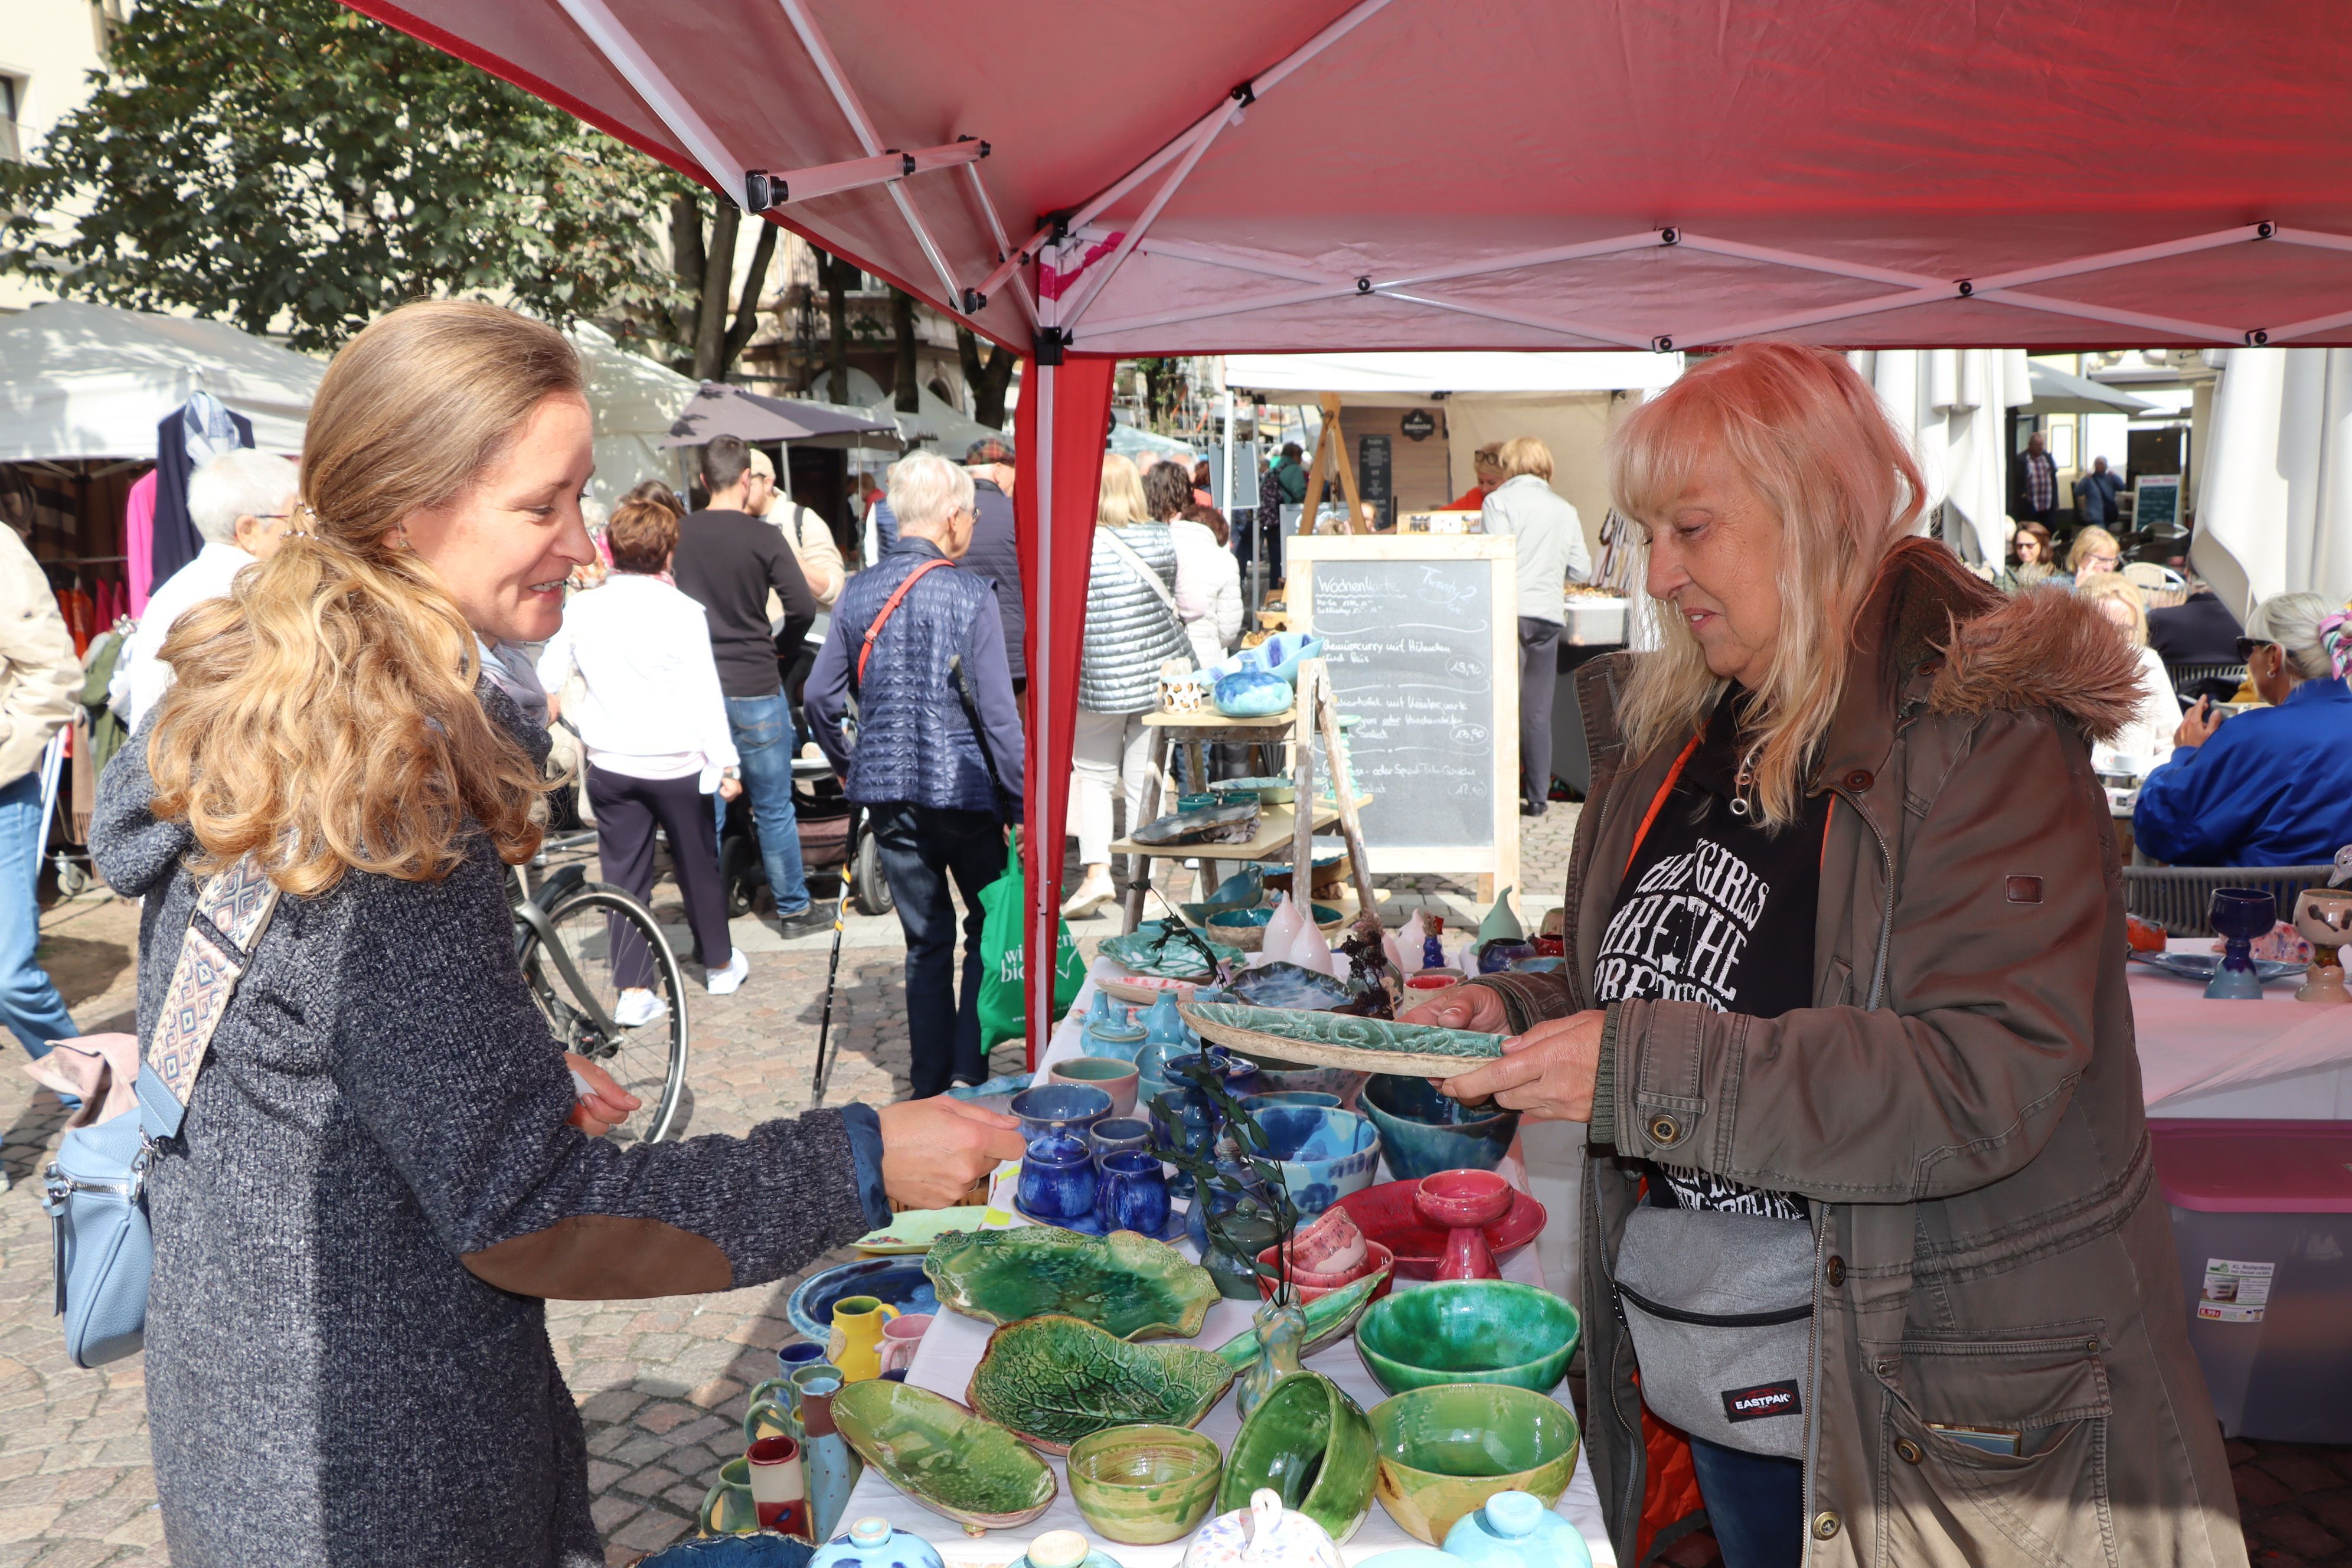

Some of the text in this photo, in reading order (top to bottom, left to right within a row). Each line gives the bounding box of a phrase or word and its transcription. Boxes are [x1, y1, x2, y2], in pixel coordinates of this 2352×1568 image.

[1386, 638, 1405, 653] mit
[1386, 695, 1404, 708] mit
[1381, 714, 1402, 725] oder
[1355, 727, 1389, 739] Salat
[1372, 764, 1393, 776] oder
[1696, 842, 1770, 932] GIRLS
[1596, 894, 1748, 1001] ARE THE
[1735, 1393, 1789, 1410] EASTPAK
